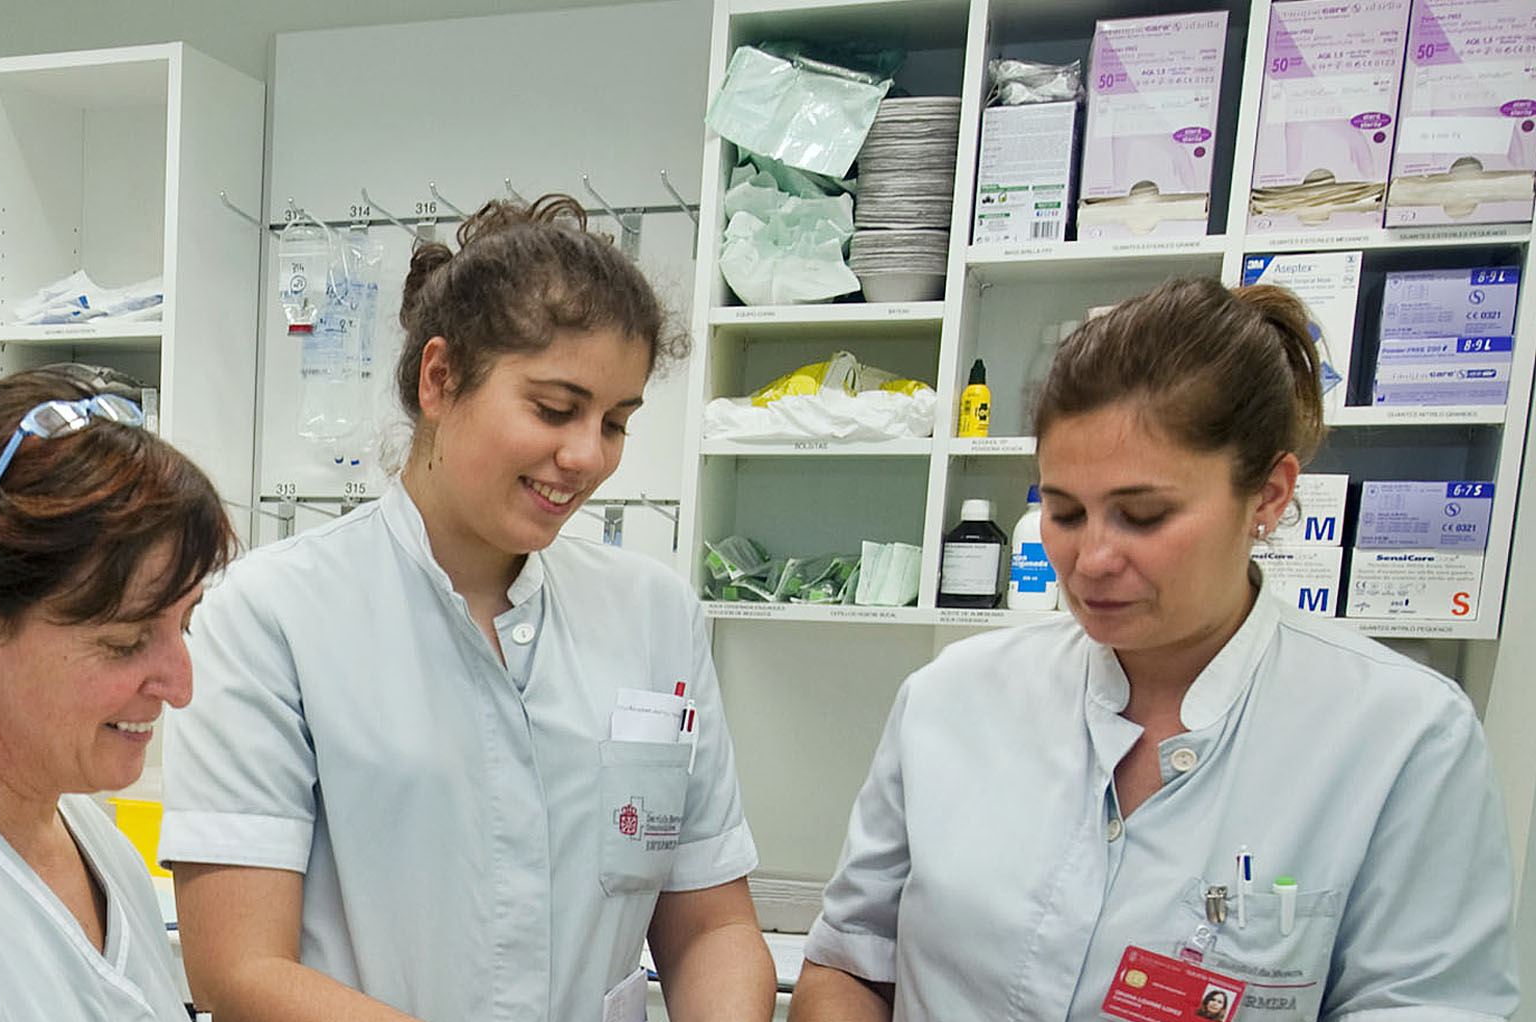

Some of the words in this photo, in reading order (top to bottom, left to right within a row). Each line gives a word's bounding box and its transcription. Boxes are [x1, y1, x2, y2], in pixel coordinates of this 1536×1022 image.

[1417, 43, 1435, 60] 50
[1271, 57, 1289, 73] 50
[1098, 73, 1114, 89] 50
[350, 206, 370, 217] 314
[415, 202, 437, 214] 316
[1498, 271, 1505, 282] L
[1480, 311, 1501, 319] 0321
[1484, 339, 1491, 350] L
[275, 482, 296, 496] 313
[345, 481, 366, 495] 315
[1473, 485, 1483, 496] S
[1305, 516, 1336, 541] M
[1455, 524, 1476, 532] 0321
[1298, 588, 1329, 612] M
[1452, 591, 1470, 616] S
